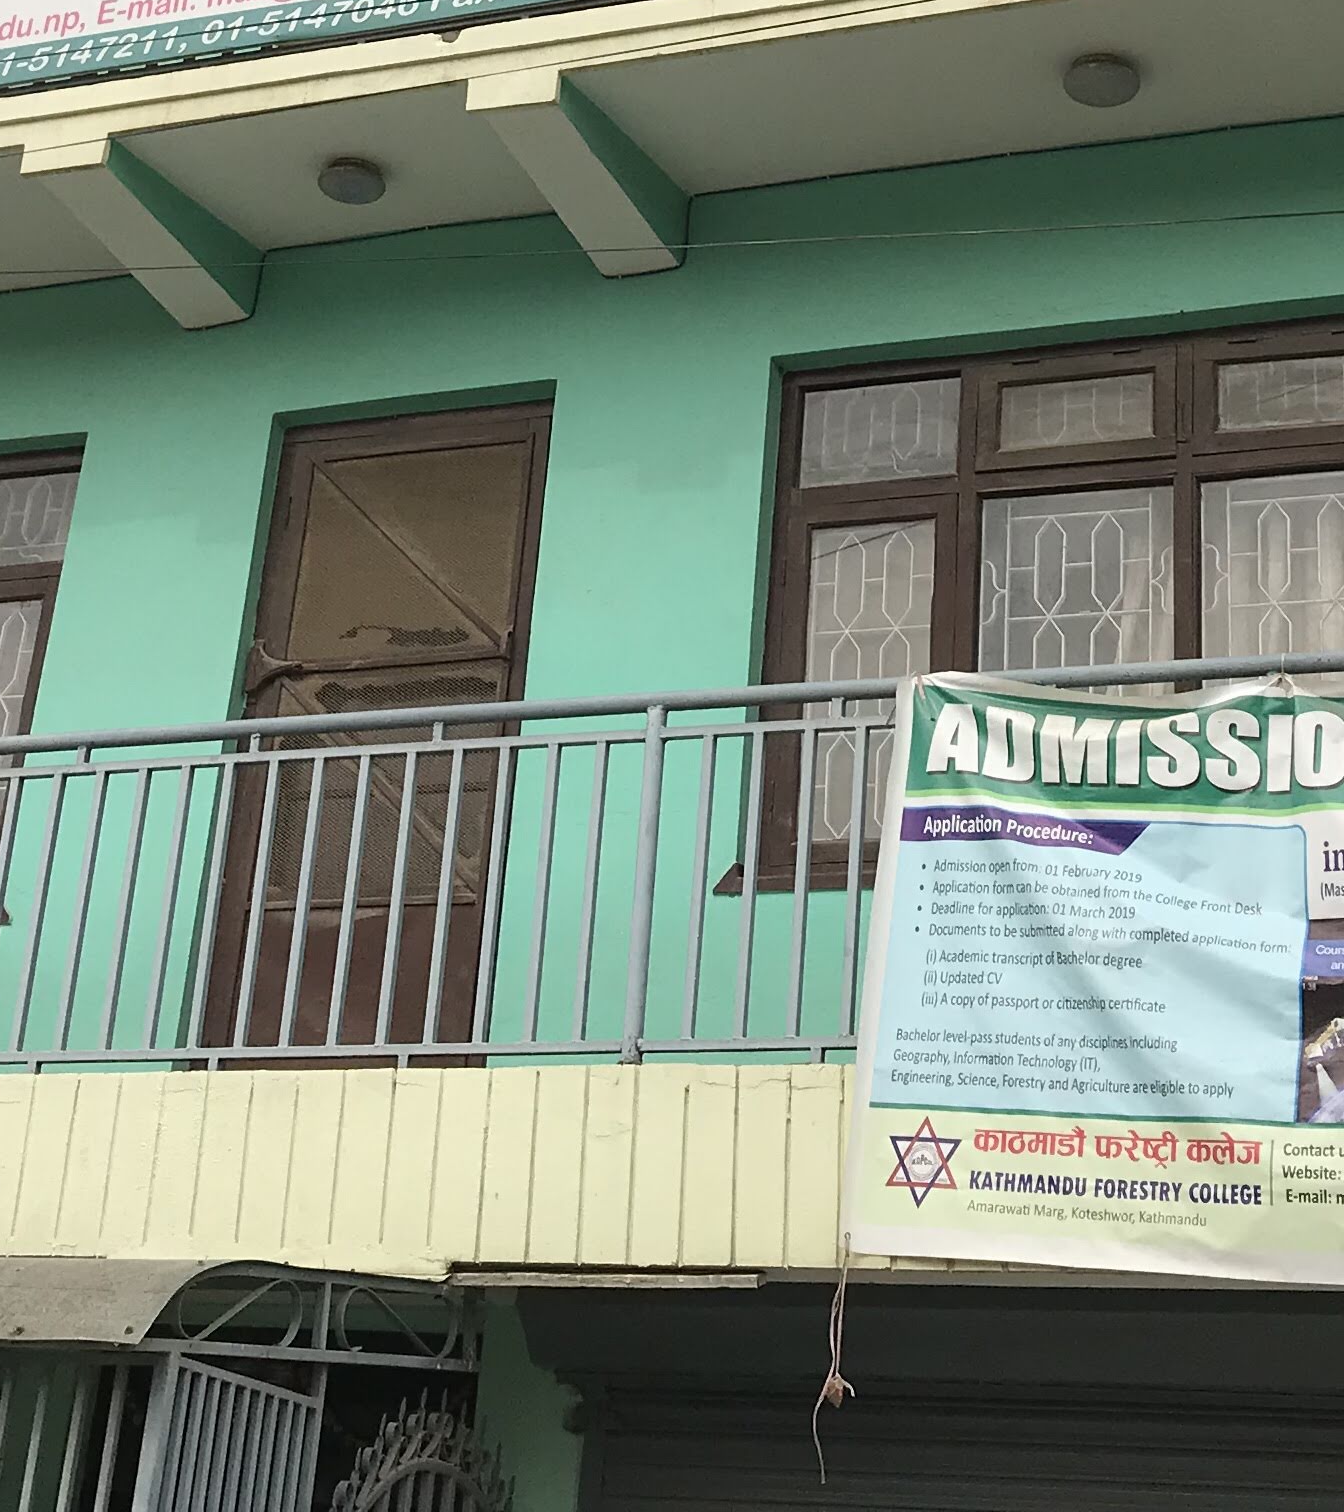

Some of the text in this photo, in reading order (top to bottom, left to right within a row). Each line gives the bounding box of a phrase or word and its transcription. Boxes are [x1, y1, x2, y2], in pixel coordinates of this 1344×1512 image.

[923, 814, 1093, 844] Application Procedure:
[934, 859, 986, 873] Admission
[989, 861, 1011, 875] open
[1045, 864, 1058, 877] 01
[1062, 865, 1111, 880] February
[1114, 869, 1143, 883] 2019
[932, 880, 1263, 915] Application form can be obtained from the College Front Desk
[931, 902, 974, 915] Deadline
[978, 902, 993, 915] for
[1052, 903, 1066, 915] 01
[1070, 905, 1105, 918] March
[1108, 906, 1136, 919] 2019
[929, 923, 986, 936] Documents
[989, 925, 1001, 937] to
[1004, 924, 1017, 937] be
[1020, 924, 1064, 938] submitted
[1068, 925, 1099, 940] along
[1102, 927, 1126, 939] with
[1130, 927, 1189, 944] completed
[1192, 934, 1256, 951] application
[926, 949, 1142, 970] (i) Academic transcript of Bachelor degree
[924, 970, 1003, 986] (ii) Updated CV
[940, 992, 948, 1005] A
[950, 995, 975, 1008] copy
[978, 993, 989, 1006] of
[991, 995, 1039, 1010] passport
[1042, 998, 1054, 1009] or
[1056, 996, 1105, 1012] citizenship
[1108, 998, 1166, 1013] certificate
[896, 1028, 941, 1042] Bachelor
[994, 1032, 1041, 1046] students
[1044, 1033, 1055, 1047] of
[1057, 1037, 1076, 1051] any
[1079, 1035, 1128, 1051] disciplines
[1129, 1036, 1178, 1053] including
[893, 1048, 1101, 1073] Geography, Information Technology (IT),
[891, 1069, 1234, 1099] Engineering, Science, Forestry and Agriculture are eligible to apply
[1187, 1131, 1263, 1165] कलेज
[1283, 1143, 1335, 1157] Contact
[1282, 1165, 1342, 1181] Website:
[969, 1170, 1262, 1205] KATHMANDU FORESTRY COLLEGE
[1286, 1188, 1332, 1204] E-mail:
[967, 1199, 1207, 1227] Amarawati Marg, Koteshwor, Kathmandu
